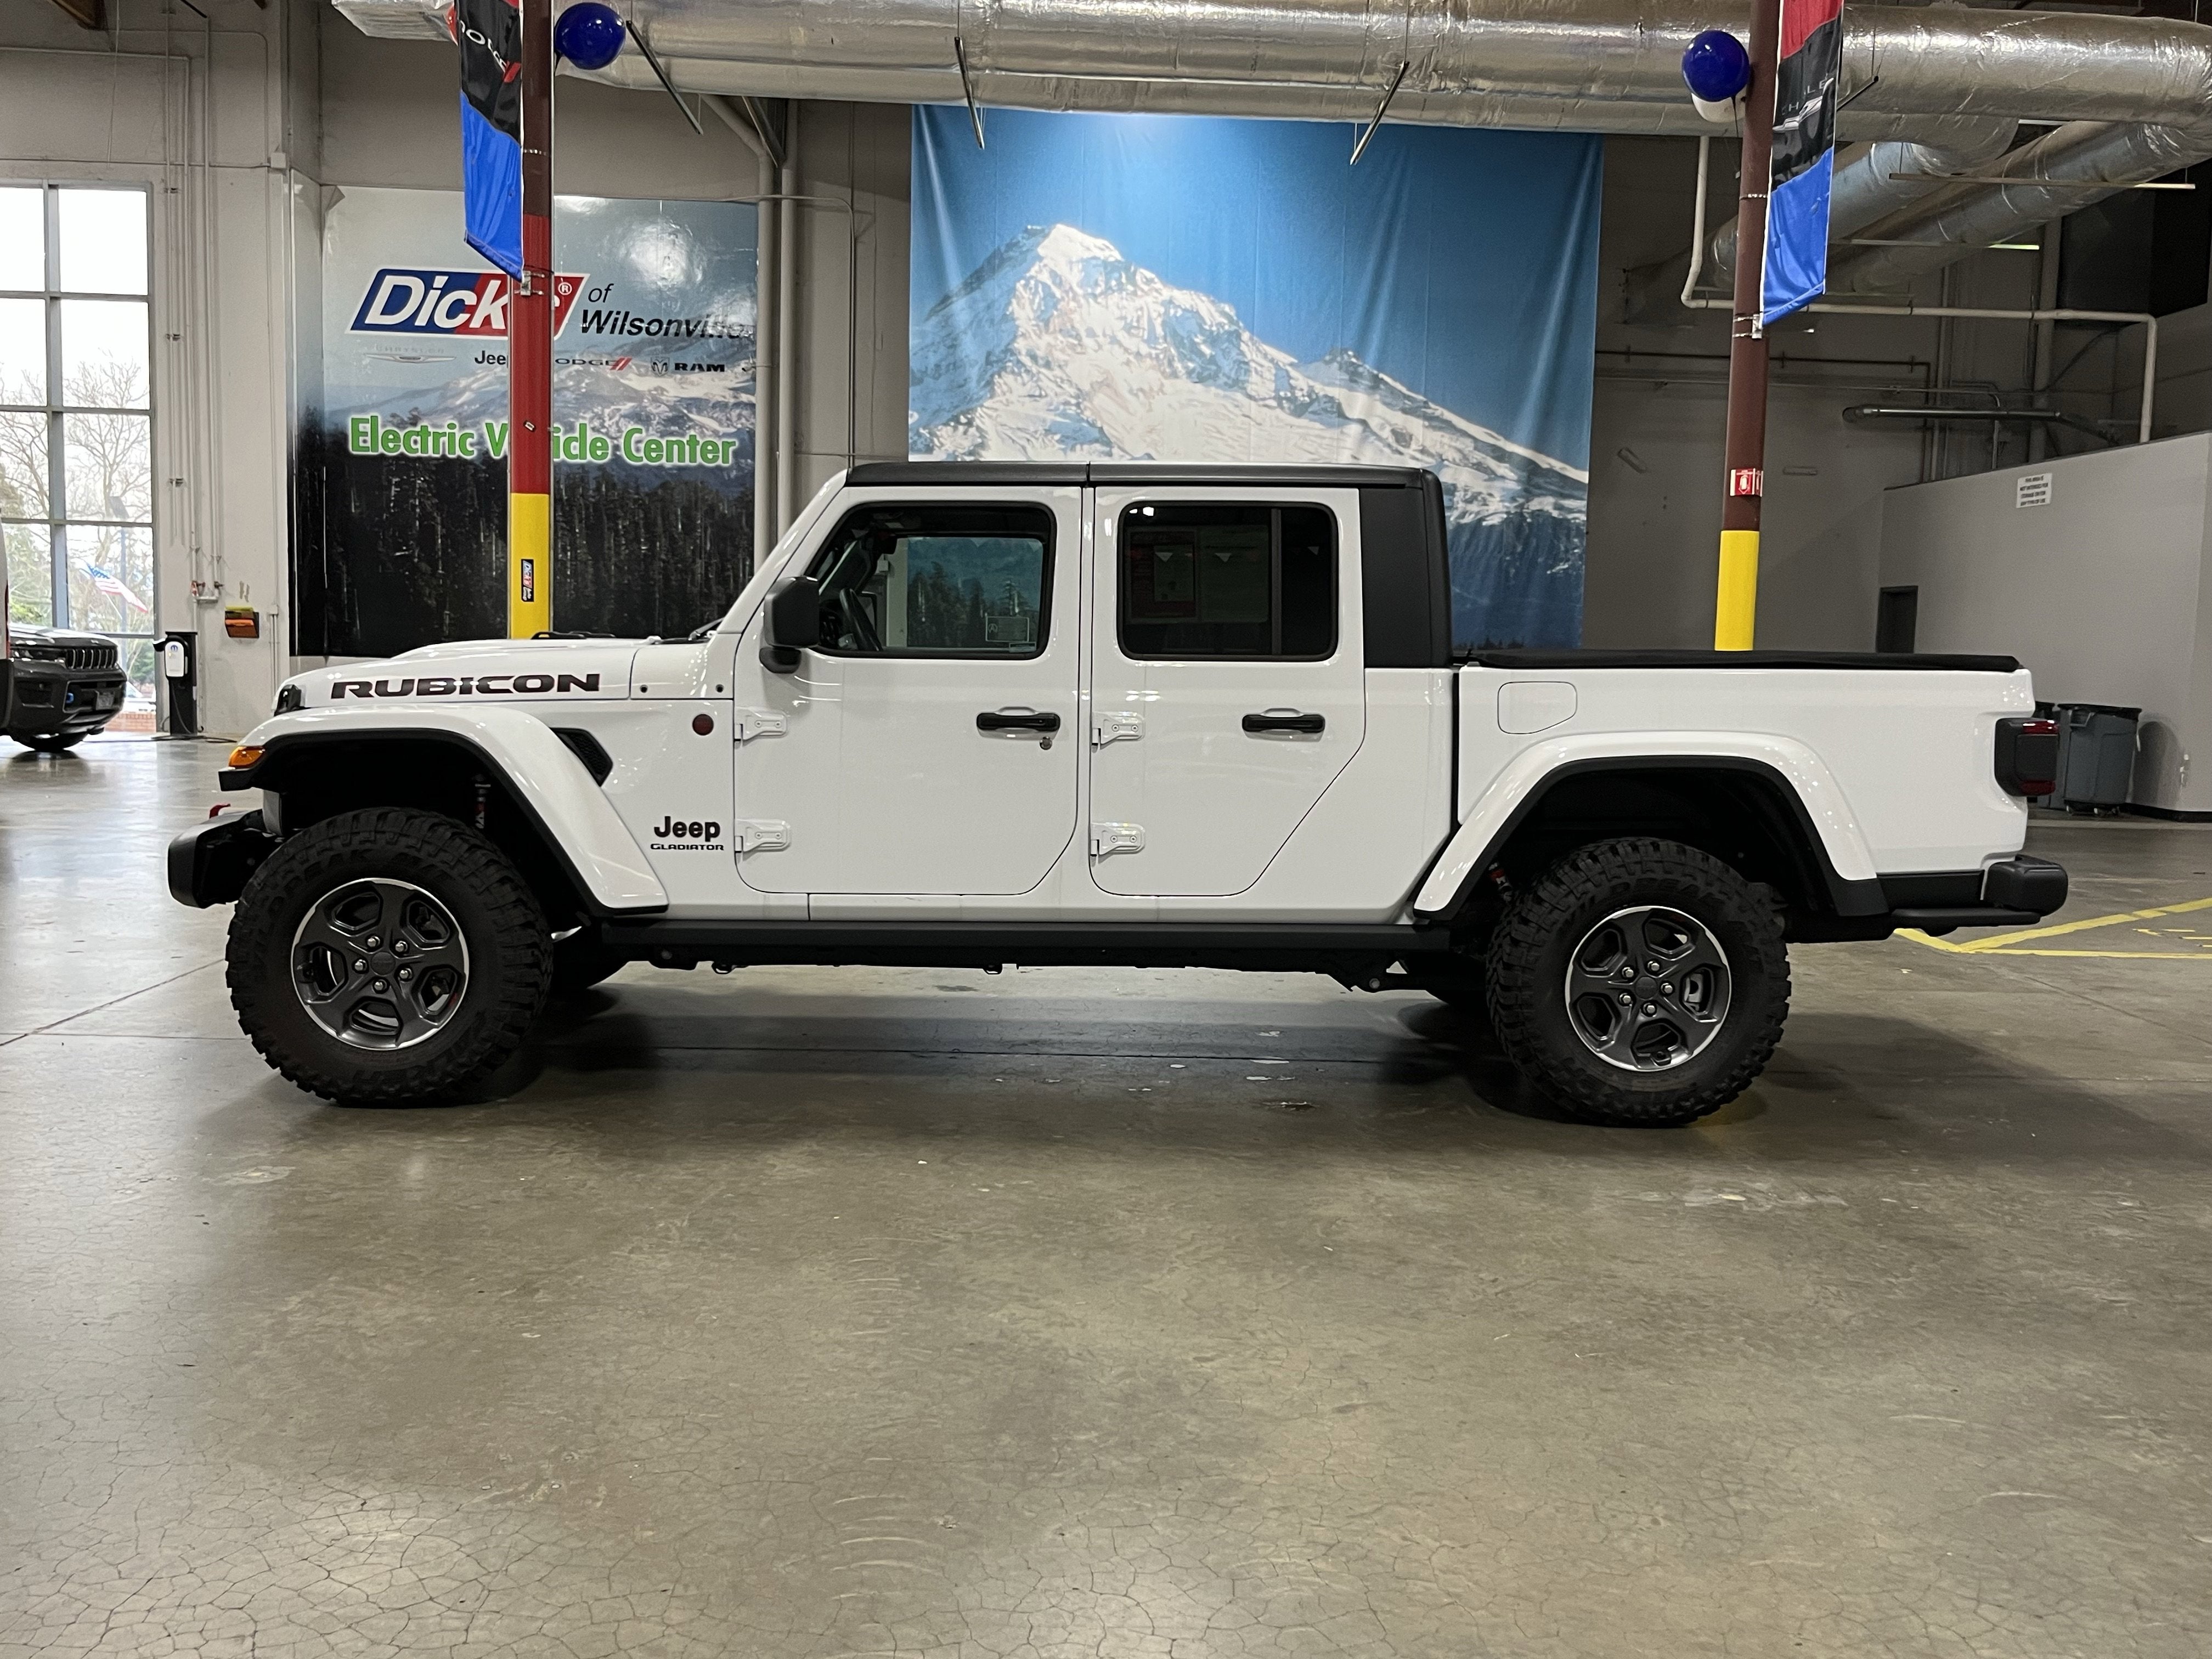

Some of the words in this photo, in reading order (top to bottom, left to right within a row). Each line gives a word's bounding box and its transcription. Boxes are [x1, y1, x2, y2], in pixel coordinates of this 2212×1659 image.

[364, 274, 560, 329] Dick
[588, 283, 614, 303] of
[474, 350, 509, 369] Jee
[674, 362, 725, 373] RAM
[351, 415, 475, 457] Electric
[484, 422, 610, 461] Vicle
[623, 427, 737, 465] Center
[330, 673, 601, 699] RUBICON
[653, 815, 721, 843] Jeep
